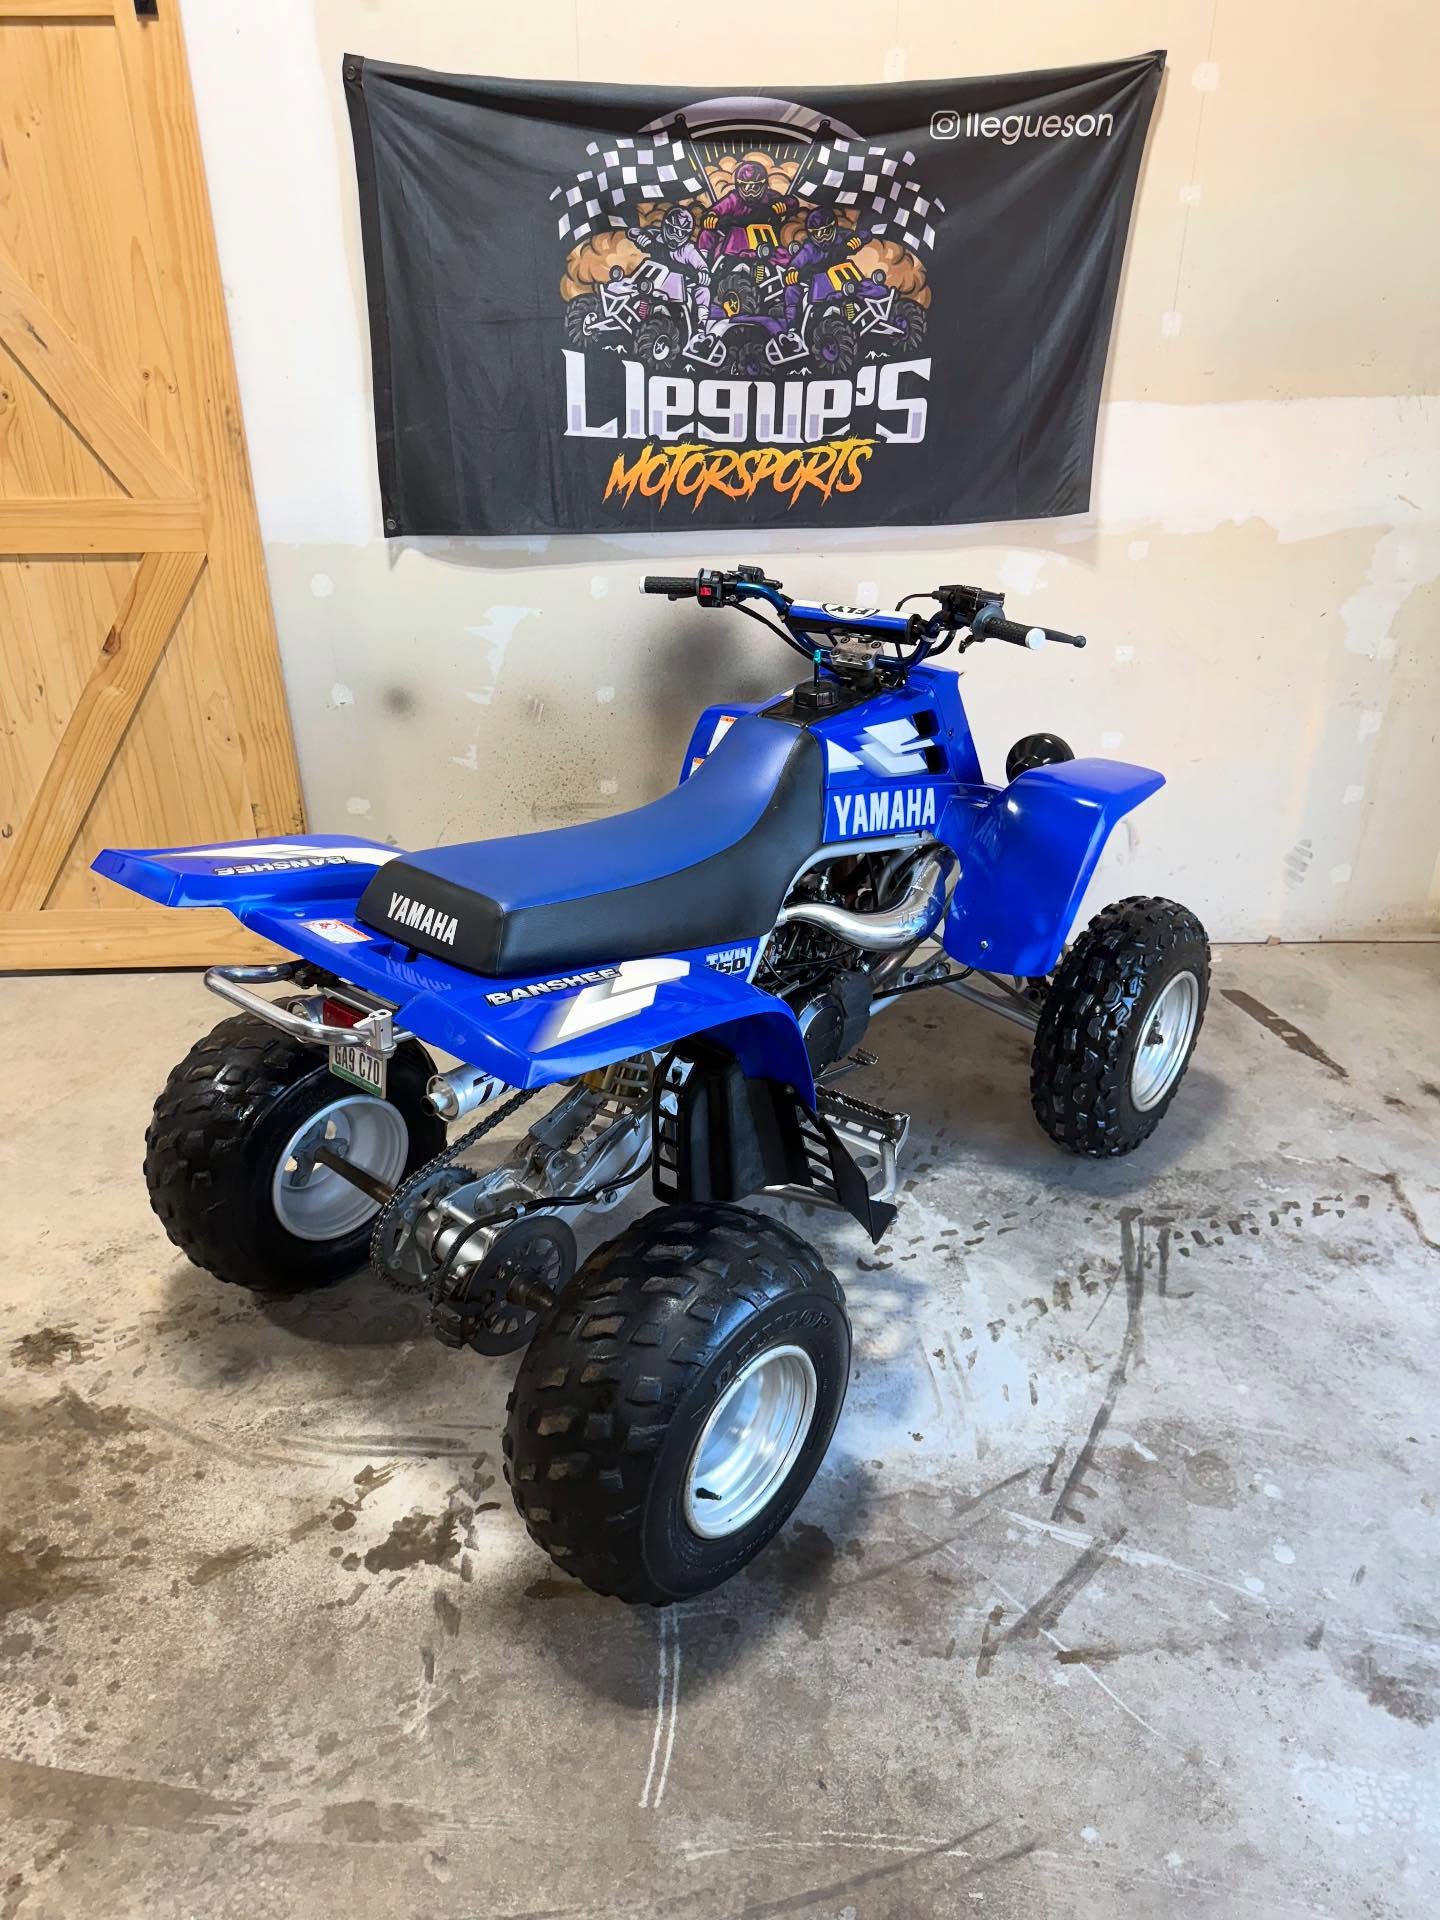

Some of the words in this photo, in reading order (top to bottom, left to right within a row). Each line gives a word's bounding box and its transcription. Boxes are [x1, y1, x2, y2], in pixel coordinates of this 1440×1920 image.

[966, 112, 1114, 146] llegueson
[602, 435, 880, 513] MOTORSPORTS
[833, 787, 936, 835] YAMAHA
[214, 855, 348, 876] BANSHEE
[387, 892, 459, 946] YAMAHA
[704, 946, 752, 968] TWIN
[484, 967, 620, 1007] BANSHEE
[335, 1045, 355, 1072] GA9
[359, 1052, 380, 1085] C70
